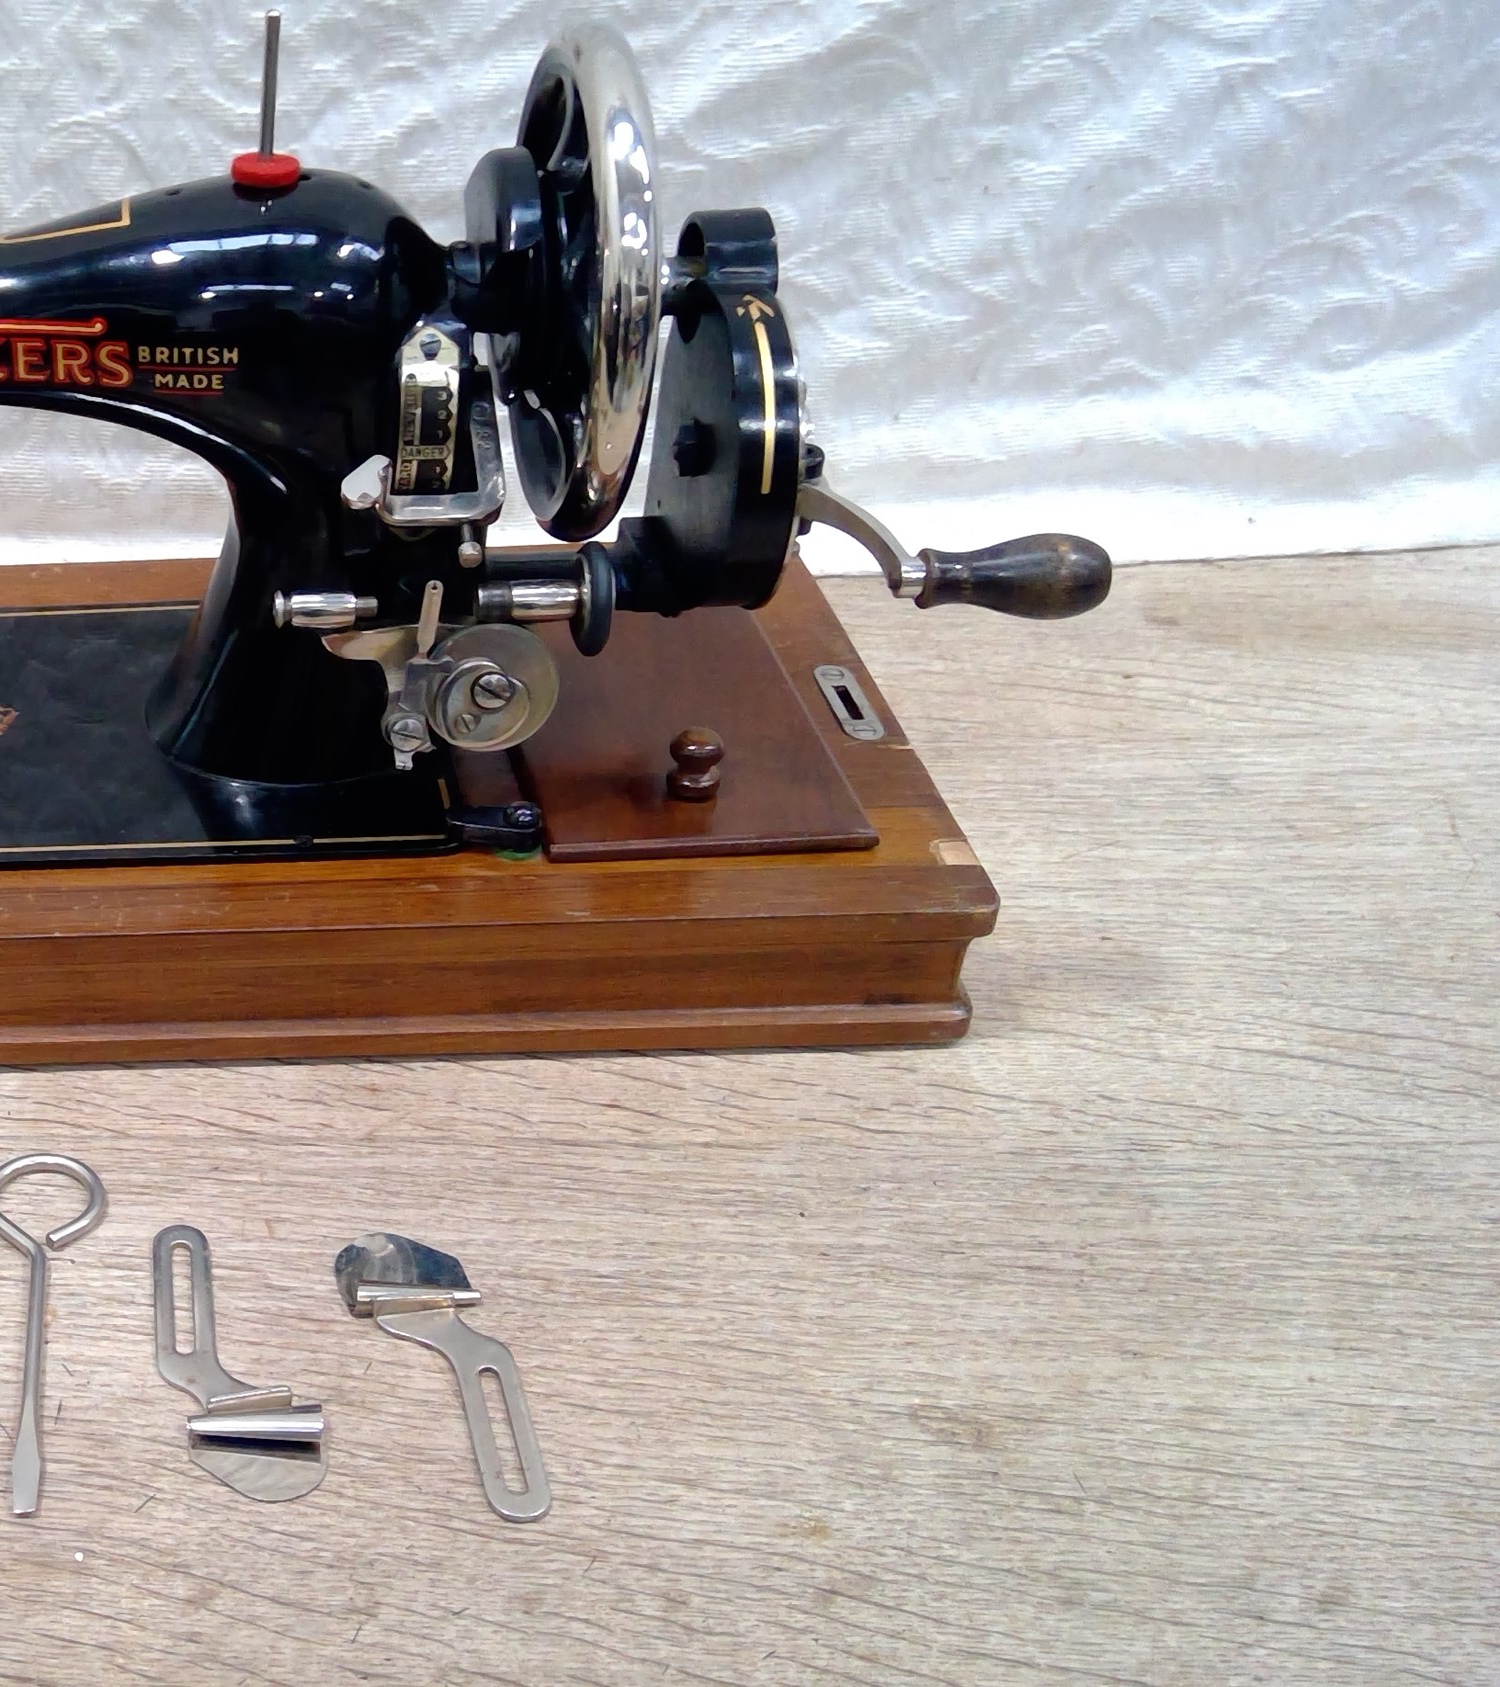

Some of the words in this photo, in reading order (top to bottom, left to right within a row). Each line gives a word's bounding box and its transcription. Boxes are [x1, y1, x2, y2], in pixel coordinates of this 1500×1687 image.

[137, 345, 239, 365] BRITISH
[153, 373, 225, 390] MADE
[401, 447, 446, 458] DANGER
